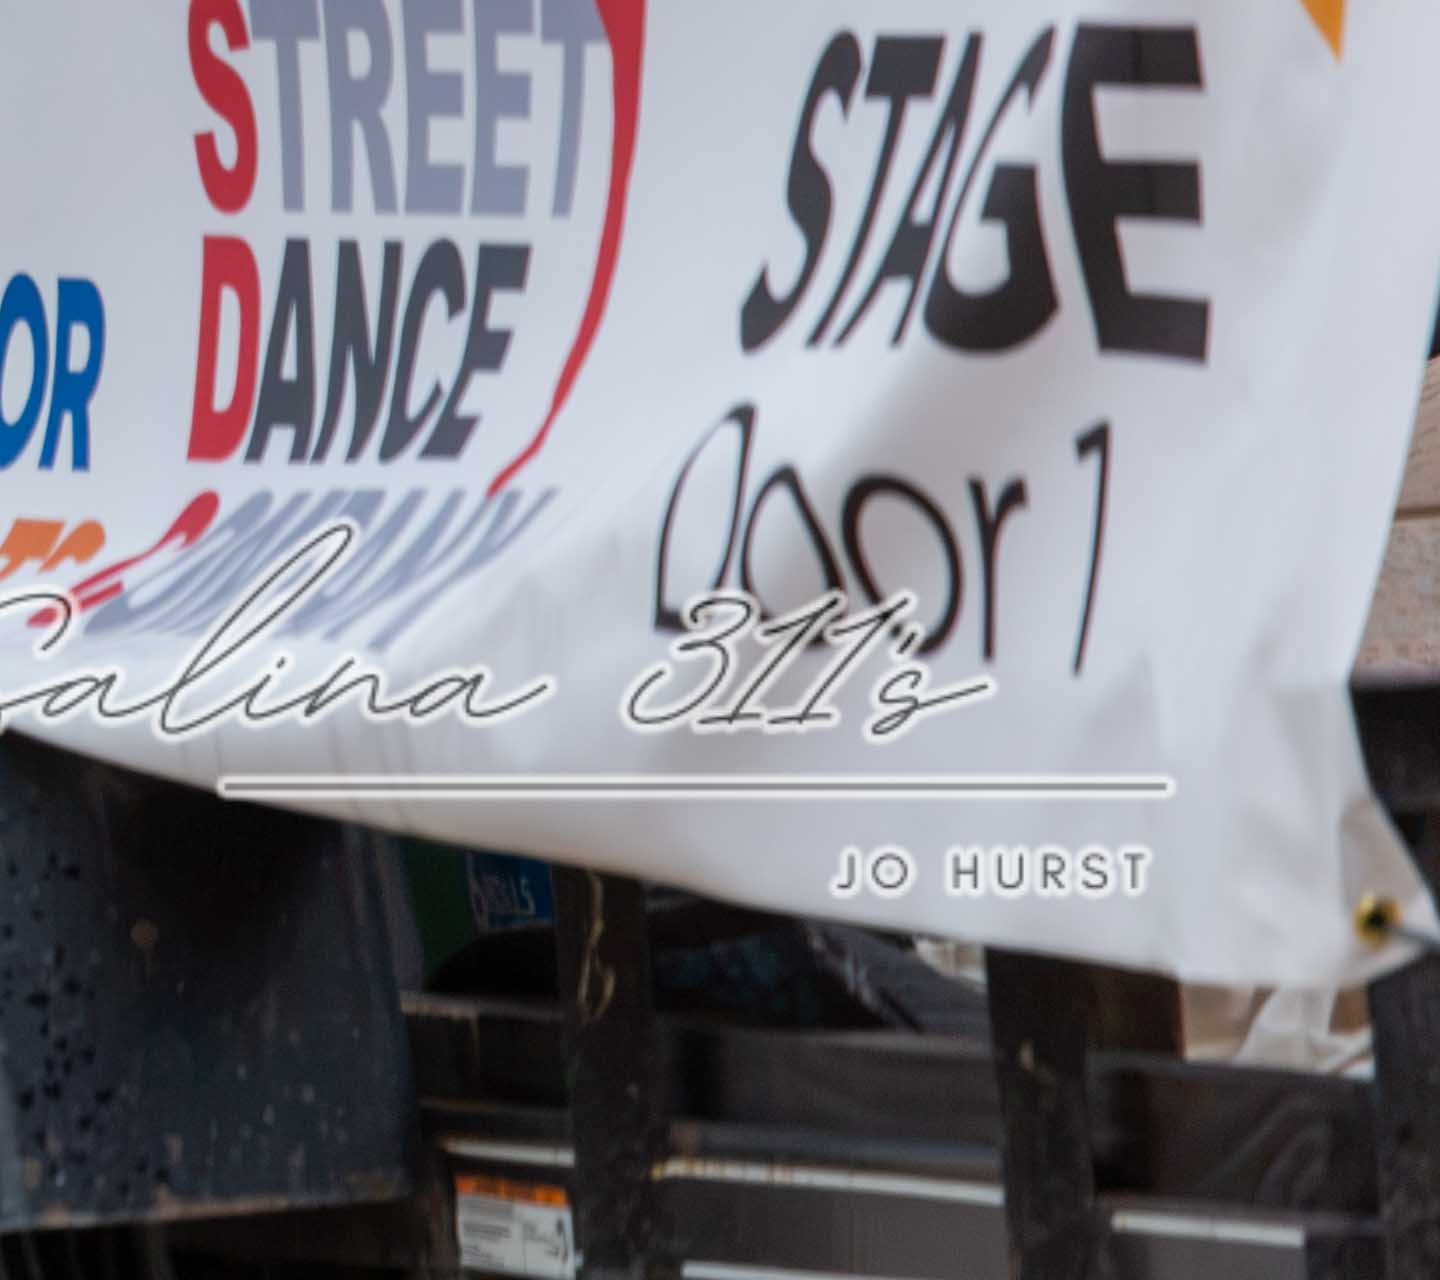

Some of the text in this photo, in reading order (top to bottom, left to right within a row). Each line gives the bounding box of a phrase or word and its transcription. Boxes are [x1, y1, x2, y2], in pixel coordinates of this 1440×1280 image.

[738, 20, 1211, 368] STAGE
[186, 235, 532, 463] DANCE
[653, 401, 1110, 677] Door 1
